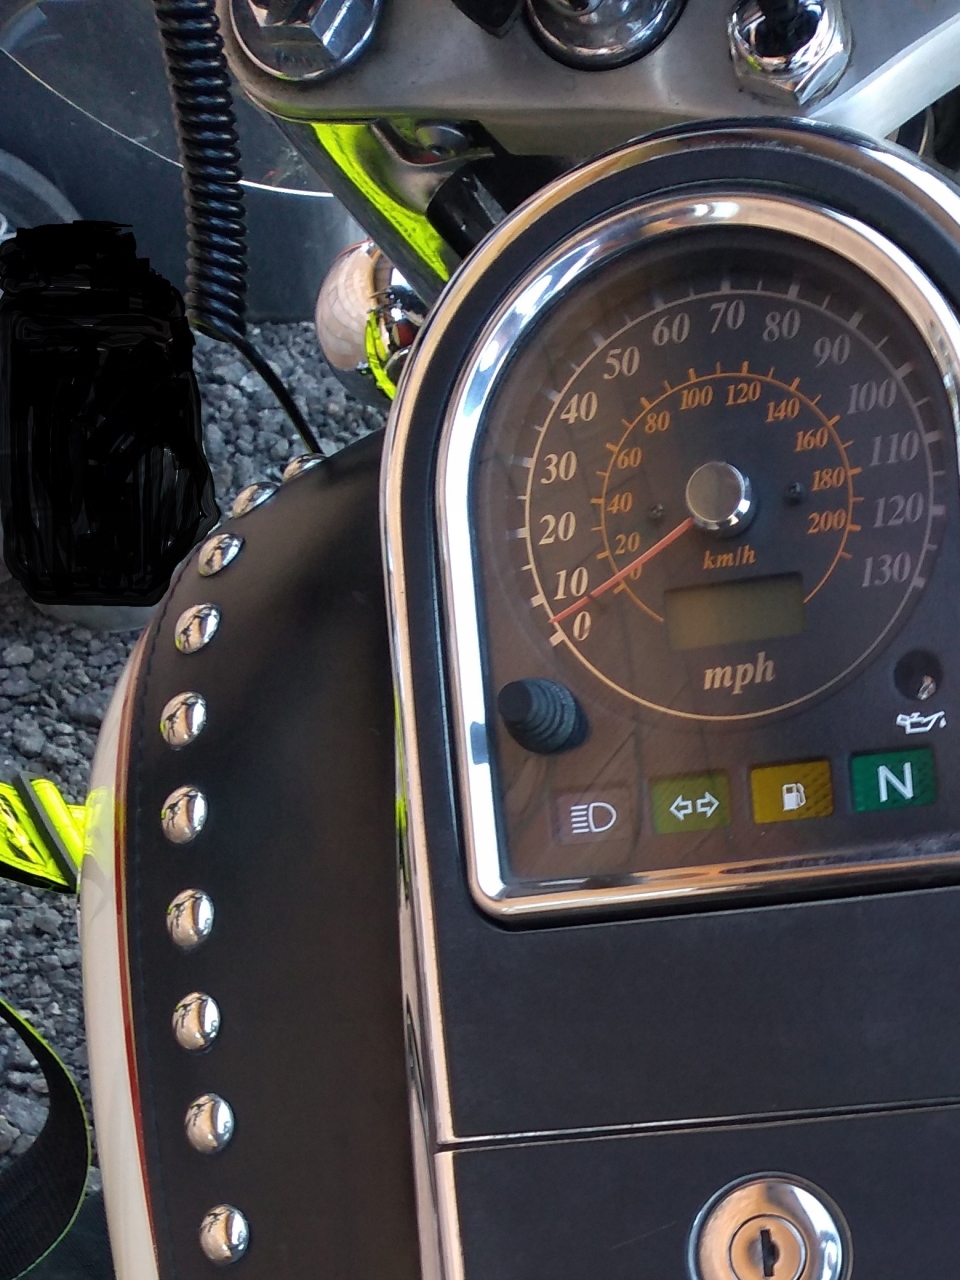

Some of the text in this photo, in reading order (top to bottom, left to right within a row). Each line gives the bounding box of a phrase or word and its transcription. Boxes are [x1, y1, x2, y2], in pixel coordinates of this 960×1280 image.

[653, 313, 690, 345] 60
[710, 300, 745, 334] 70
[762, 308, 800, 342] 80
[603, 346, 640, 379] 50
[814, 334, 849, 367] 90
[560, 392, 598, 424] 40
[680, 385, 713, 410] 100
[726, 381, 761, 405] 120
[846, 379, 897, 415] 100
[645, 411, 670, 433] 80
[765, 398, 800, 423] 140
[794, 427, 828, 452] 160
[870, 430, 919, 466] 110
[541, 451, 577, 484] 30
[617, 447, 642, 470] 60
[811, 467, 844, 491] 180
[607, 492, 633, 513] 40
[873, 492, 922, 528] 120
[538, 511, 576, 545] 20
[808, 510, 846, 534] 200
[615, 532, 640, 555] 20
[703, 545, 756, 570] km/h
[554, 567, 588, 600] 10
[861, 553, 911, 588] 130
[572, 611, 591, 641] 0
[703, 651, 775, 695] mph
[876, 762, 914, 802] N
